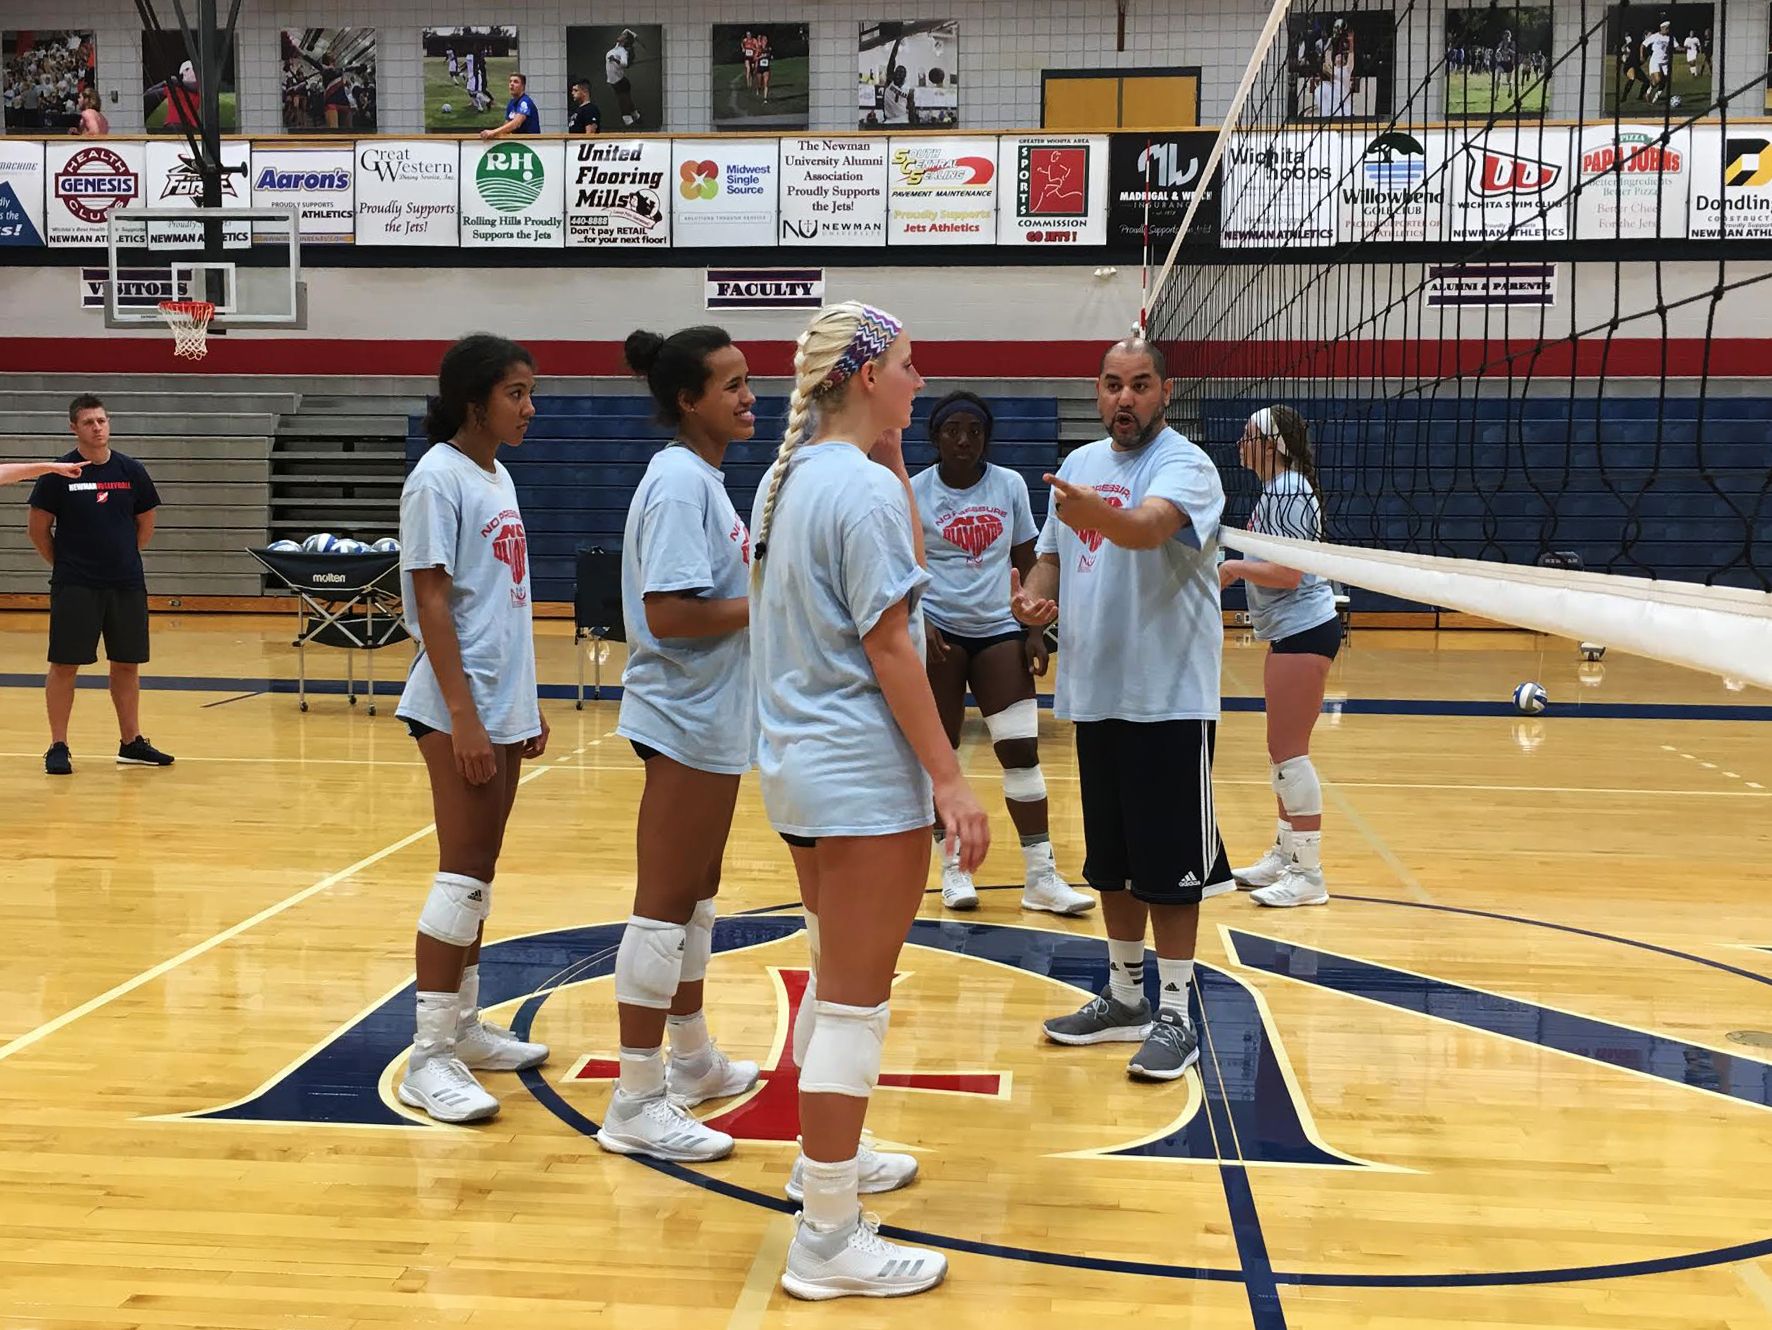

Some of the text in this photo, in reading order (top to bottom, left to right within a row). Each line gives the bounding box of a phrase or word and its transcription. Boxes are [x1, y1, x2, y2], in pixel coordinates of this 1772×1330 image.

[798, 140, 870, 151] The Newman
[577, 143, 644, 162] United
[1231, 148, 1304, 164] Wichita
[68, 151, 125, 173] HEALTH
[361, 149, 410, 171] Great
[486, 152, 533, 171] RH
[785, 156, 883, 168] University Alumni
[374, 161, 452, 182] Western
[726, 165, 771, 174] Midwest
[256, 168, 350, 190] Aaron's
[576, 166, 664, 189] Flooring
[727, 175, 760, 185] Single
[804, 172, 864, 181] Association
[1020, 147, 1030, 215] SPORTS
[61, 178, 133, 193] GENESIS
[160, 174, 238, 200] FORE
[727, 186, 764, 195] Source
[787, 186, 880, 198] Proudly Supports
[1171, 191, 1179, 200] &
[575, 189, 629, 208] Mills
[1696, 195, 1772, 213] Dondlin
[359, 200, 455, 219] Proudly Supports
[812, 201, 854, 213] the Jets!
[6, 210, 20, 220] the
[301, 210, 353, 218] ATHLETICS
[894, 210, 991, 221] Proudly Supports
[384, 216, 428, 233] the Jets!
[463, 217, 562, 229] Rolling Hills Proudly
[904, 223, 980, 232] Jets Athletics
[473, 230, 551, 242] Supports the Jets
[570, 227, 647, 236] Don't pay RETAIL
[1026, 231, 1042, 242] GO
[1224, 229, 1333, 240] NEWMAN ATHLETICS
[49, 235, 145, 243] NEWMAN ATETICS
[150, 232, 248, 244] NEWMAN AETICS
[598, 237, 618, 245] your
[88, 282, 188, 296] VSITORS
[717, 283, 814, 296] FACULTY
[935, 513, 952, 526] NO
[312, 573, 346, 583] molten
